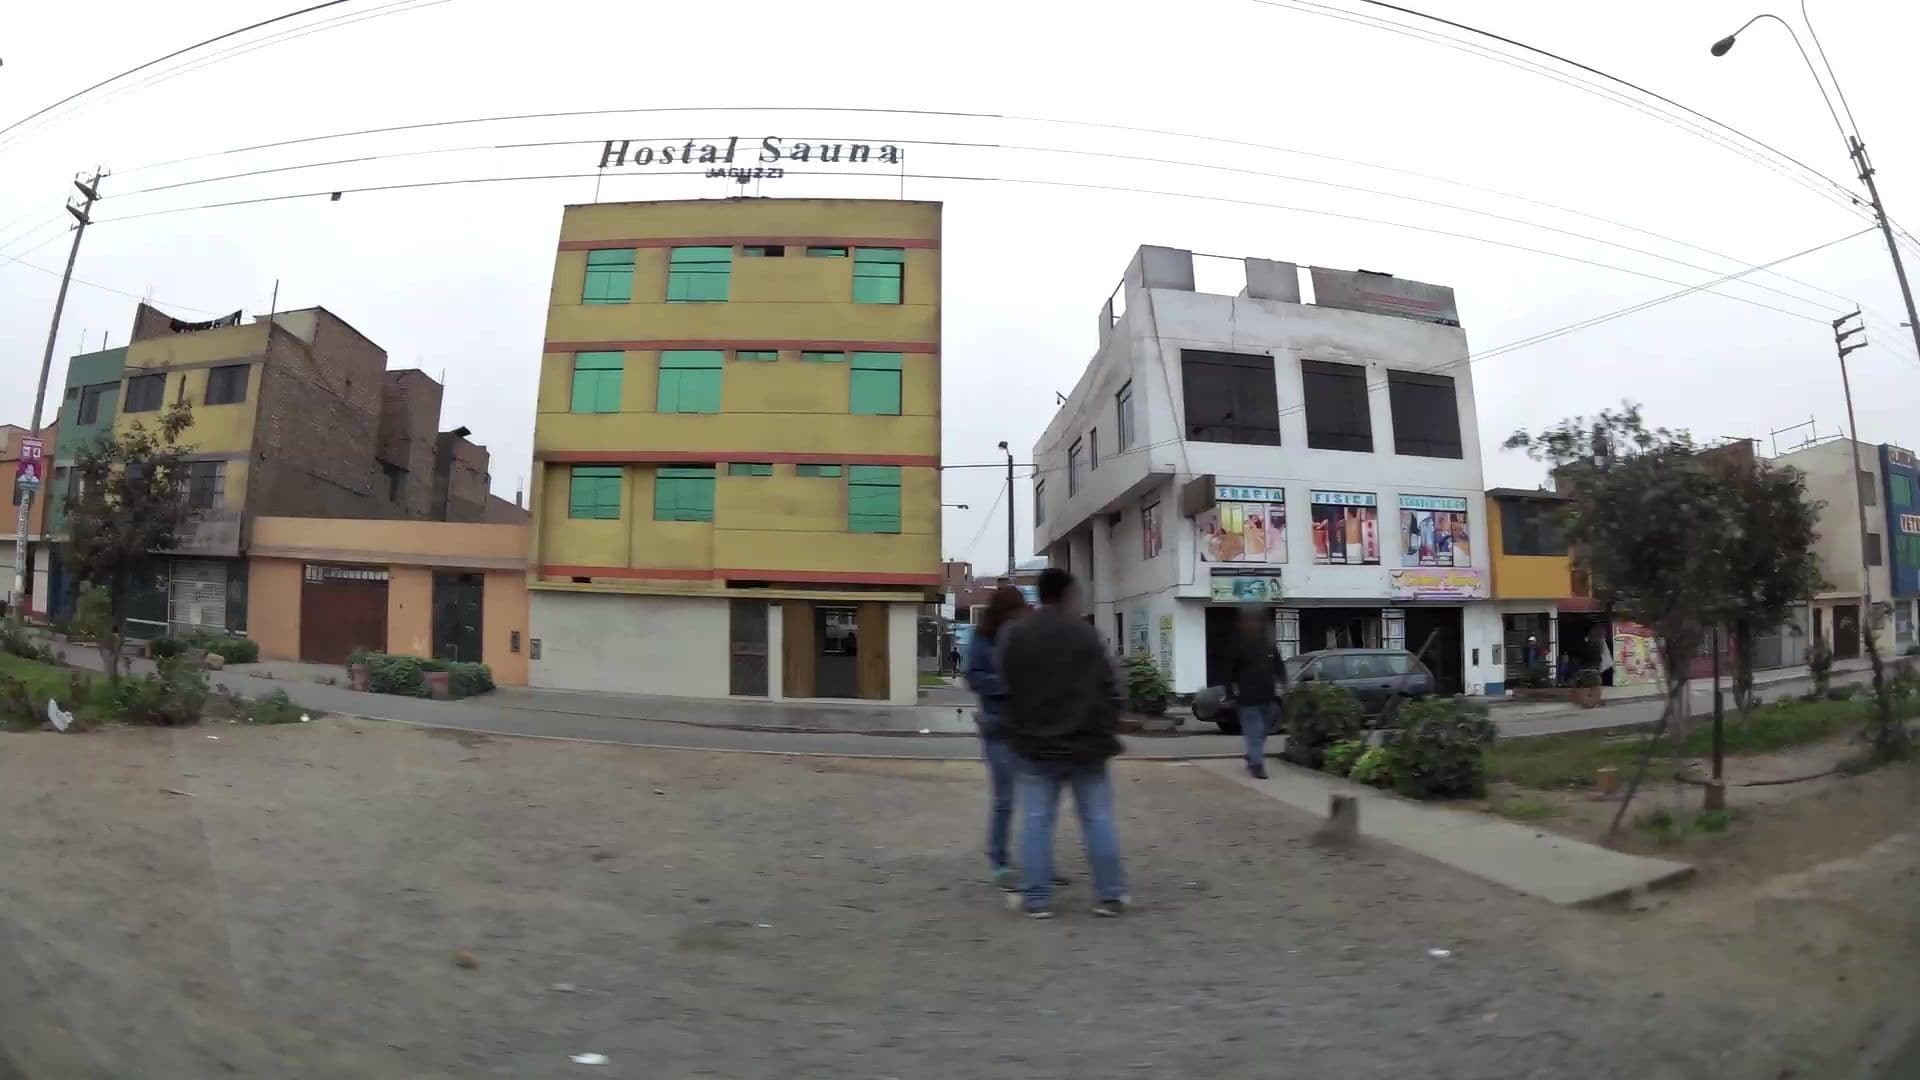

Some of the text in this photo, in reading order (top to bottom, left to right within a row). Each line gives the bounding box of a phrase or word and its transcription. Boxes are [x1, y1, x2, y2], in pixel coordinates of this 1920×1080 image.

[597, 136, 900, 168] Hostal Sauna
[1219, 488, 1282, 500] ERAPIA
